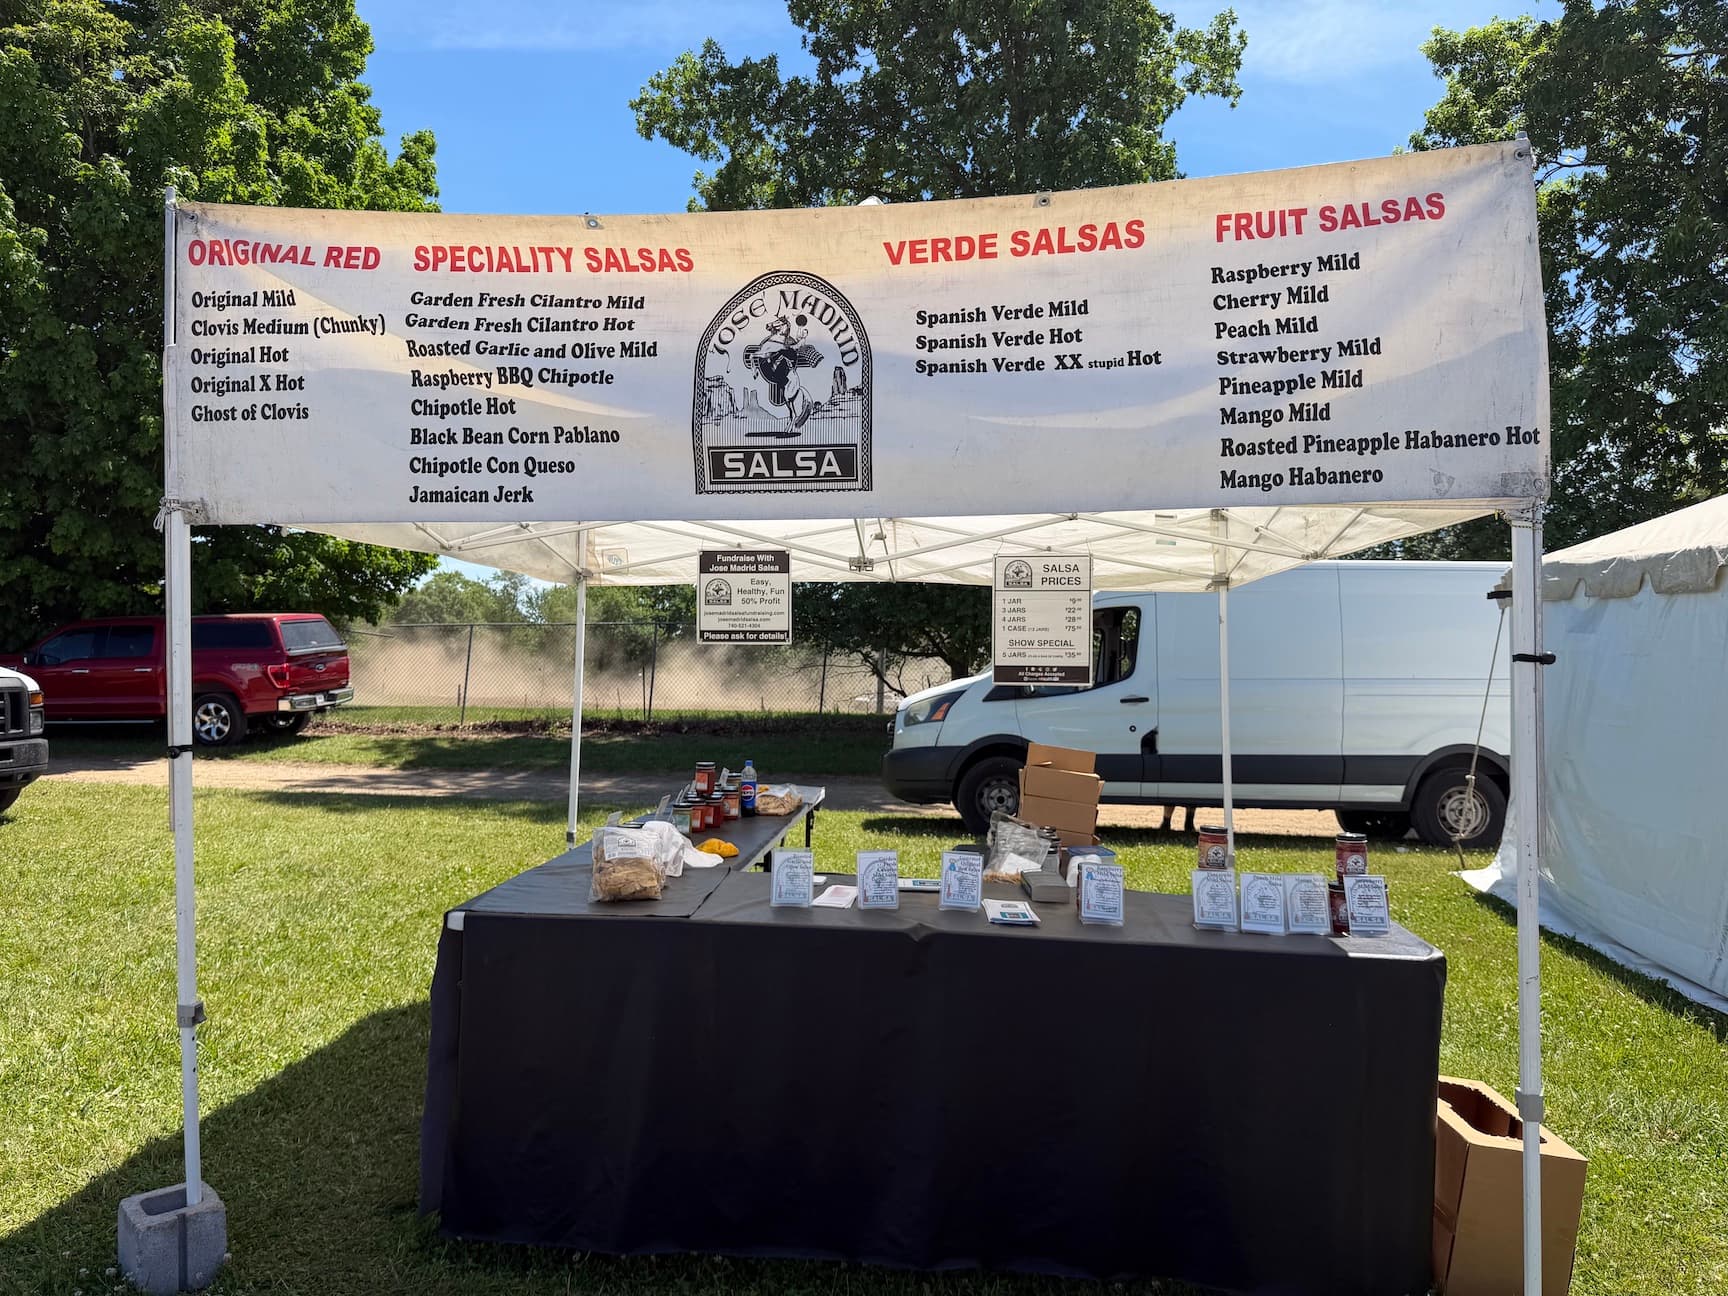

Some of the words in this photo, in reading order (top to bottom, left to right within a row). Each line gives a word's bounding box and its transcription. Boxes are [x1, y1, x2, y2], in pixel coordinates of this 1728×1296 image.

[1217, 209, 1307, 242] FRUIT
[1320, 193, 1444, 231] SALSAS
[189, 240, 315, 265] ORIGINAL
[324, 247, 380, 269] RED
[883, 233, 997, 265] VERDE
[1010, 220, 1144, 256] SALSAS
[414, 246, 573, 272] SPECIALITY
[584, 247, 693, 272] SALSAS
[1211, 262, 1312, 284] Raspberry
[1317, 252, 1360, 271] Mild
[192, 291, 257, 311] Original
[262, 290, 296, 306] Mild
[411, 292, 472, 307] Garden
[478, 293, 525, 307] Fresh
[531, 295, 602, 308] Cilantro
[607, 296, 644, 309] Mild
[1213, 293, 1281, 310] Cherry
[1287, 285, 1329, 304] Mild
[406, 314, 469, 330] Garden
[474, 318, 522, 332] Fresh
[527, 317, 598, 332] Cilantro
[603, 318, 635, 330] Hot
[916, 307, 986, 328] Spanish
[992, 304, 1043, 320] Verde
[1049, 299, 1088, 317] Mild
[192, 319, 238, 336] Clovis
[243, 319, 308, 334] Medium
[314, 314, 385, 338] (Chunky)
[775, 290, 859, 366] MADRID
[1215, 320, 1270, 339] Peach
[1275, 316, 1318, 334] Mild
[406, 340, 470, 357] Roasted
[476, 341, 529, 356] Garlic
[534, 344, 566, 358] and
[571, 343, 615, 358] Olive
[620, 342, 657, 358] Mild
[916, 333, 987, 352] Spanish
[992, 330, 1044, 347] Verde
[1050, 328, 1082, 344] Hot
[1217, 346, 1332, 365] Strawberry
[1337, 337, 1381, 357] Mild
[191, 347, 255, 368] Original
[260, 346, 288, 362] Hot
[916, 359, 987, 376] Spanish
[992, 357, 1045, 372] Verde
[1055, 354, 1083, 370] XX
[1089, 358, 1124, 369] stupid
[1127, 351, 1161, 366] Hot
[191, 376, 255, 397] Original
[259, 375, 271, 391] X
[276, 374, 304, 391] Hot
[411, 369, 492, 390] Raspberry
[497, 367, 533, 387] BBQ
[538, 368, 613, 387] Chipotle
[1219, 374, 1315, 396] Pineapple
[1321, 370, 1362, 388] Mild
[192, 406, 237, 421] Ghost
[242, 404, 257, 420] of
[261, 403, 308, 420] Clovis
[411, 399, 481, 419] Chipotle
[486, 398, 516, 414] Hot
[1220, 407, 1283, 428] Mango
[1289, 403, 1330, 422] Mild
[410, 428, 458, 444] Black
[463, 428, 503, 444] Bean
[508, 427, 549, 444] Corn
[553, 426, 619, 443] Pablano
[1221, 436, 1297, 457] Roasted
[1303, 432, 1399, 455] Pineapple
[1405, 431, 1500, 449] Habanero
[1506, 426, 1540, 445] Hot
[410, 457, 482, 477] Chipotle
[487, 457, 519, 473] Con
[524, 457, 575, 477] Queso
[724, 451, 841, 478] SALSA
[1220, 470, 1283, 492] Mango
[1289, 467, 1383, 486] Habanero
[409, 486, 489, 502] Jamaican
[494, 486, 534, 502] Jerk
[1043, 564, 1079, 573] SALSA
[737, 588, 768, 596] Healthy,
[1042, 577, 1081, 585] PRICES
